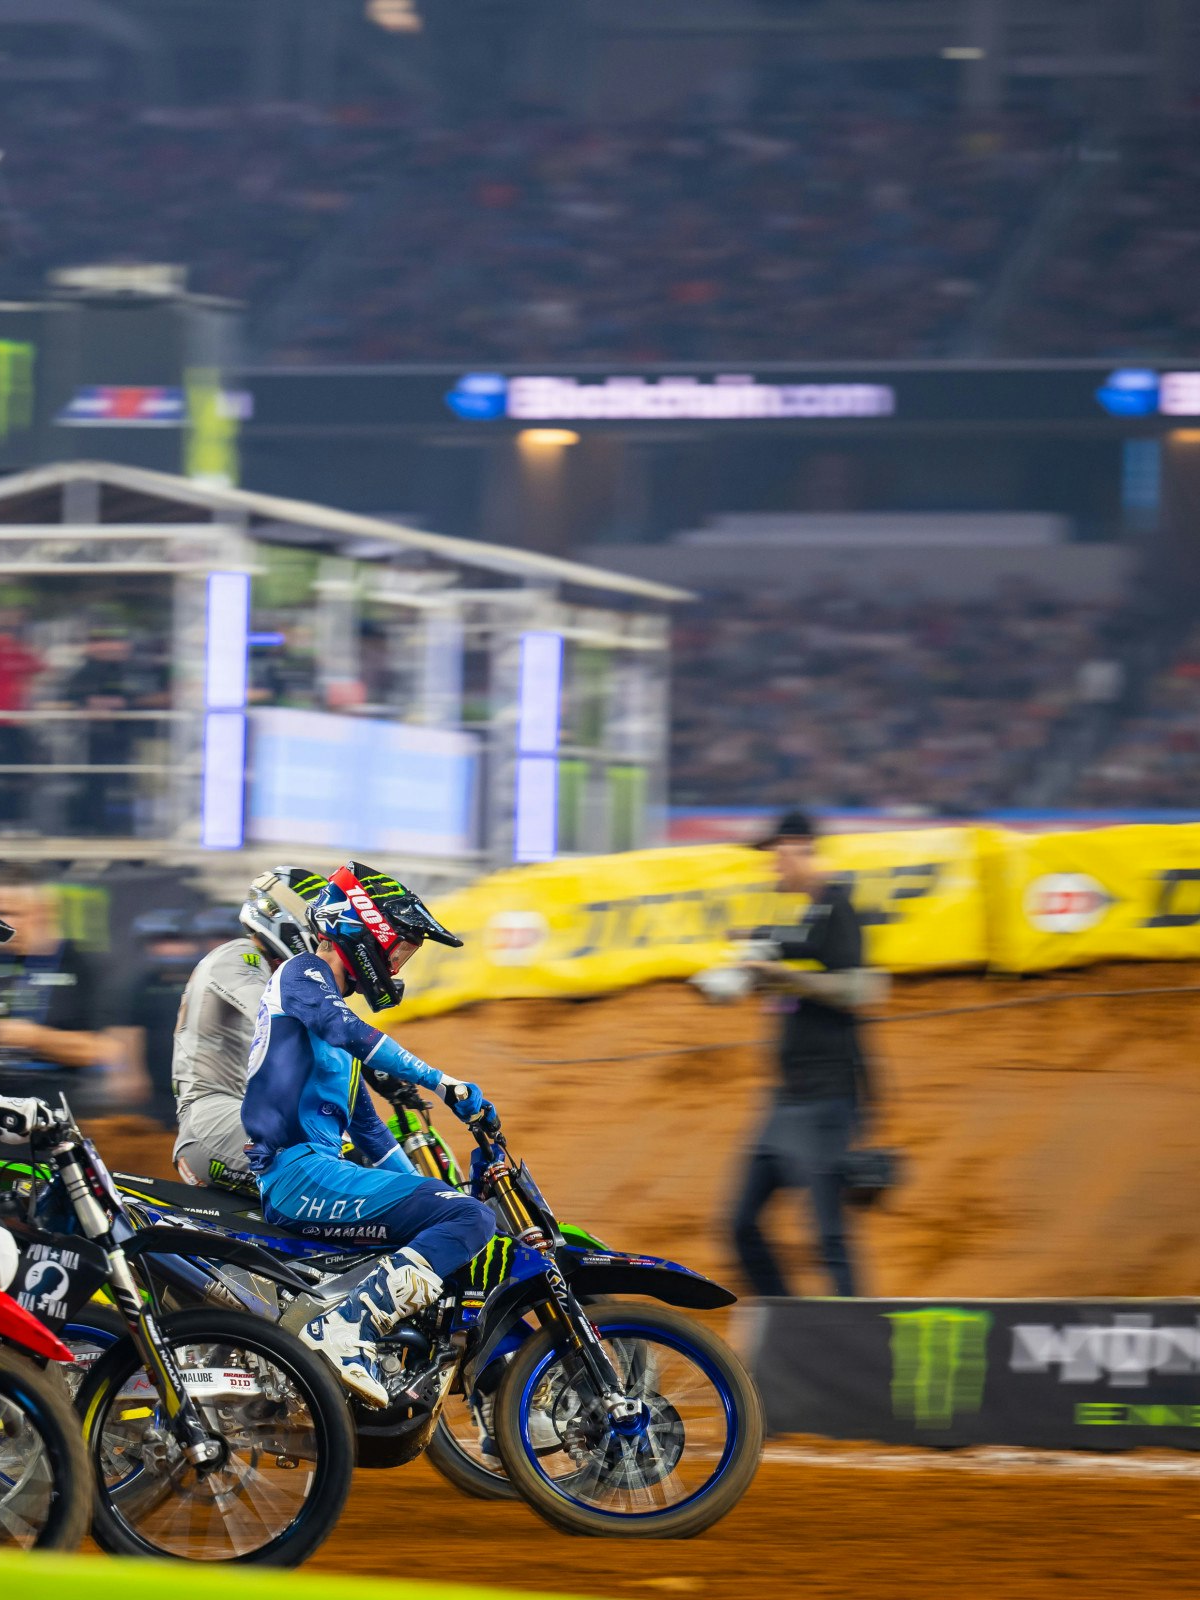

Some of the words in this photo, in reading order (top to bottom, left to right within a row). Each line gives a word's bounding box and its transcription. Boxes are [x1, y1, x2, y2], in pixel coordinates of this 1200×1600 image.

[346, 885, 396, 943] 100%
[183, 1207, 220, 1217] YAMAHA
[323, 1226, 388, 1239] YAMAHA
[60, 1249, 80, 1270] MIA
